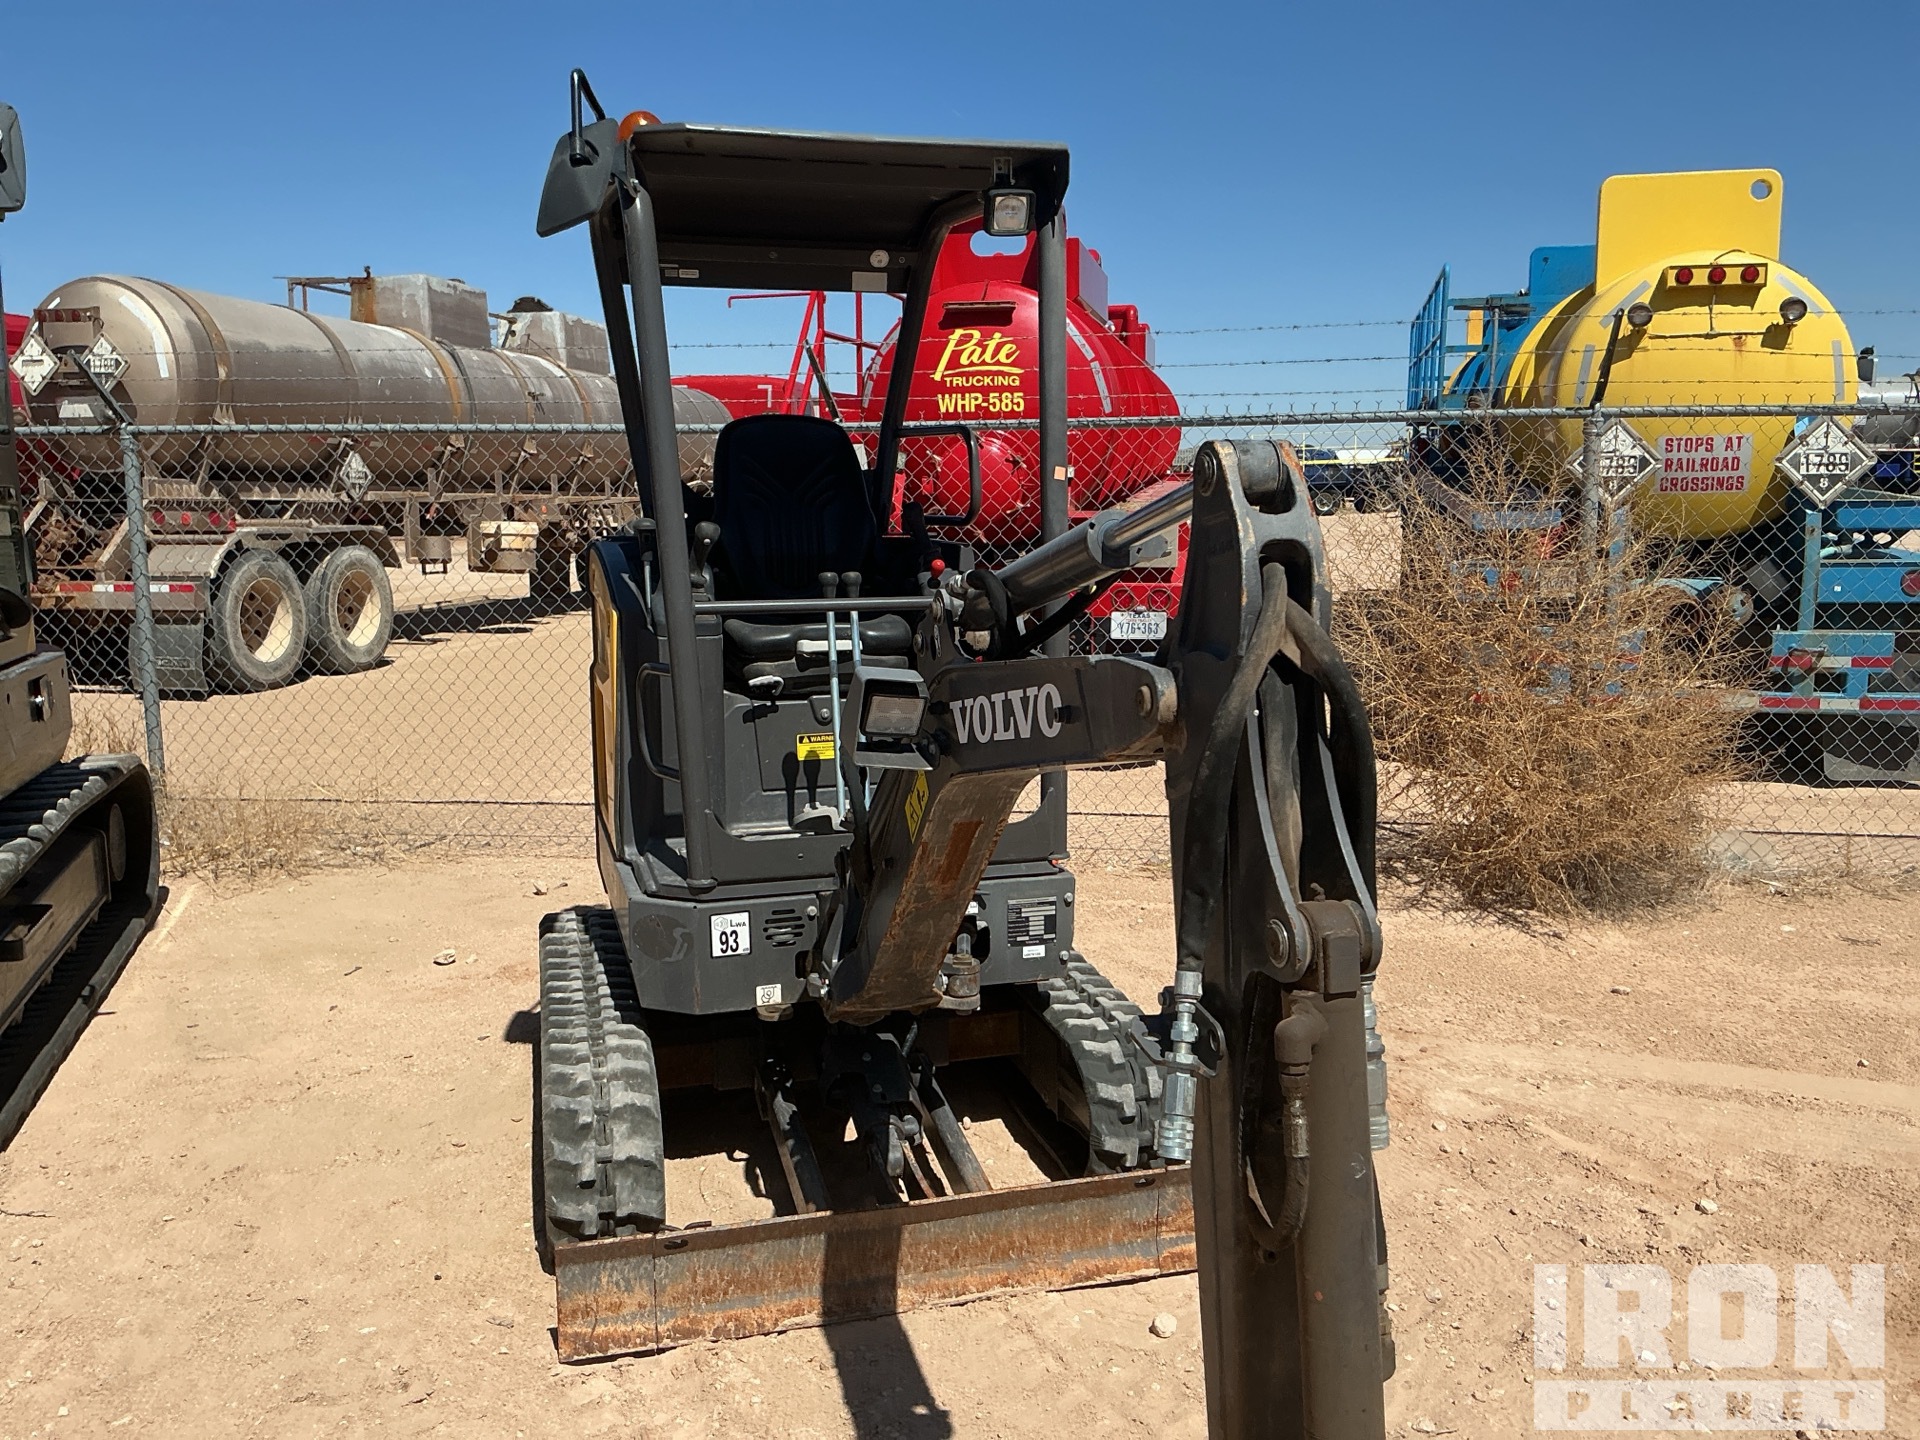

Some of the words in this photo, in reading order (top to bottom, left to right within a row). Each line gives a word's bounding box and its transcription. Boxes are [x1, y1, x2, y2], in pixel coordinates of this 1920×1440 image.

[930, 328, 1021, 381] Pate
[943, 375, 1020, 387] TRUCKING
[937, 392, 1025, 413] WHP-585
[1664, 437, 1715, 454] STOPS
[1724, 435, 1744, 452] AT
[1664, 456, 1741, 473] RAILROAD
[1802, 453, 1849, 473] 1789
[1659, 475, 1745, 492] CROSSINGS
[1819, 477, 1829, 488] 8
[949, 683, 1062, 744] VOLVO
[810, 735, 835, 743] WARNI
[719, 929, 740, 954] 93
